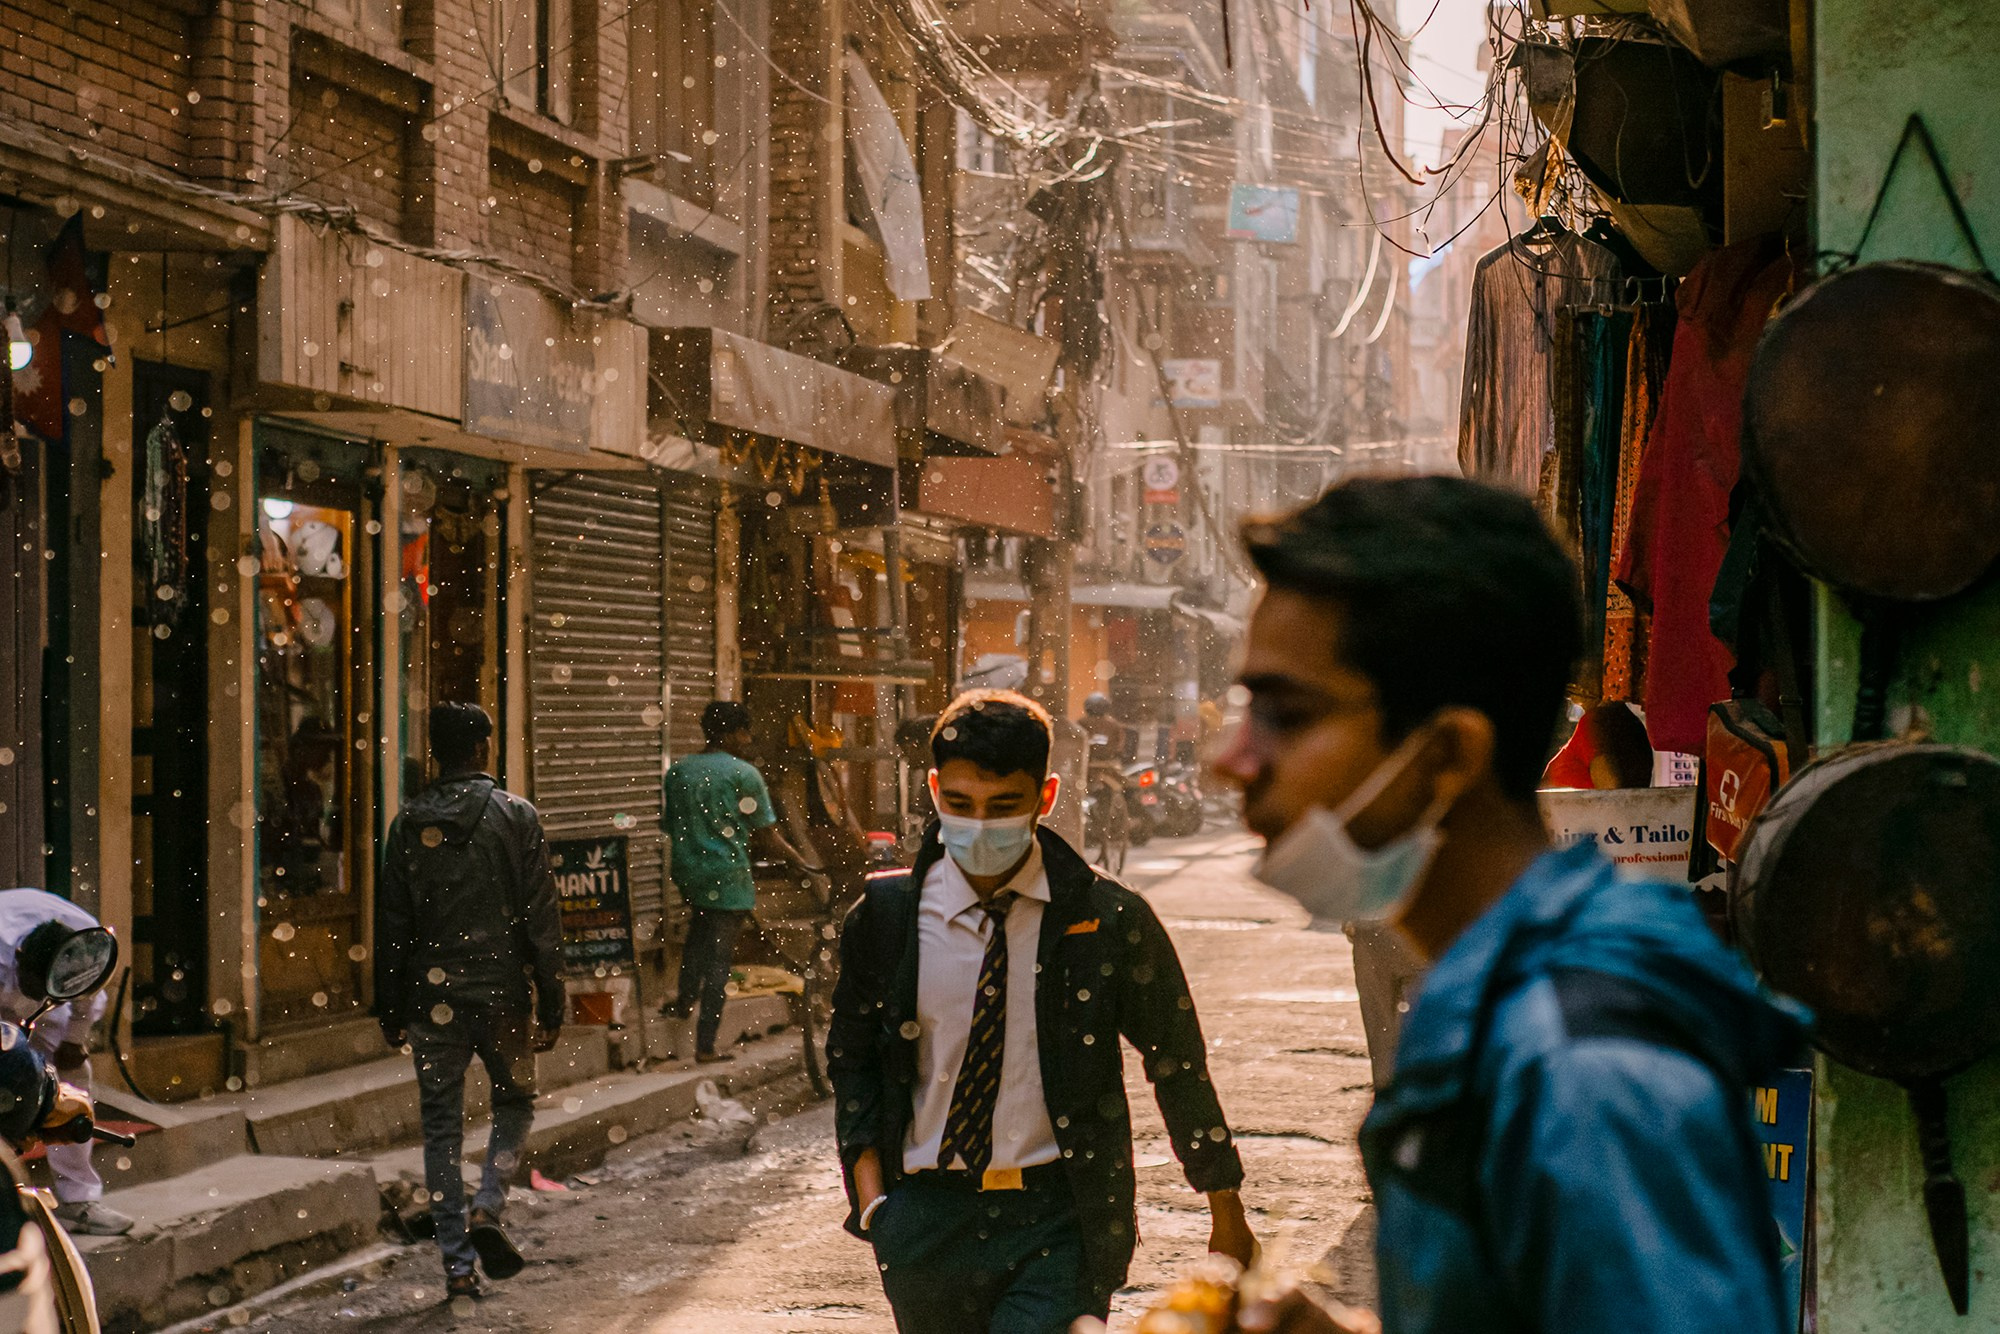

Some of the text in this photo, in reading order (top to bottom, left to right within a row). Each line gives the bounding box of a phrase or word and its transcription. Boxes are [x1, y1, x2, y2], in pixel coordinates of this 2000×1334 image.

[1604, 827, 1625, 844] &
[1630, 825, 1691, 843] Tailo
[1614, 851, 1689, 866] professional
[554, 870, 620, 896] HANTI
[1754, 1087, 1778, 1124] M
[1762, 1143, 1794, 1180] NT
